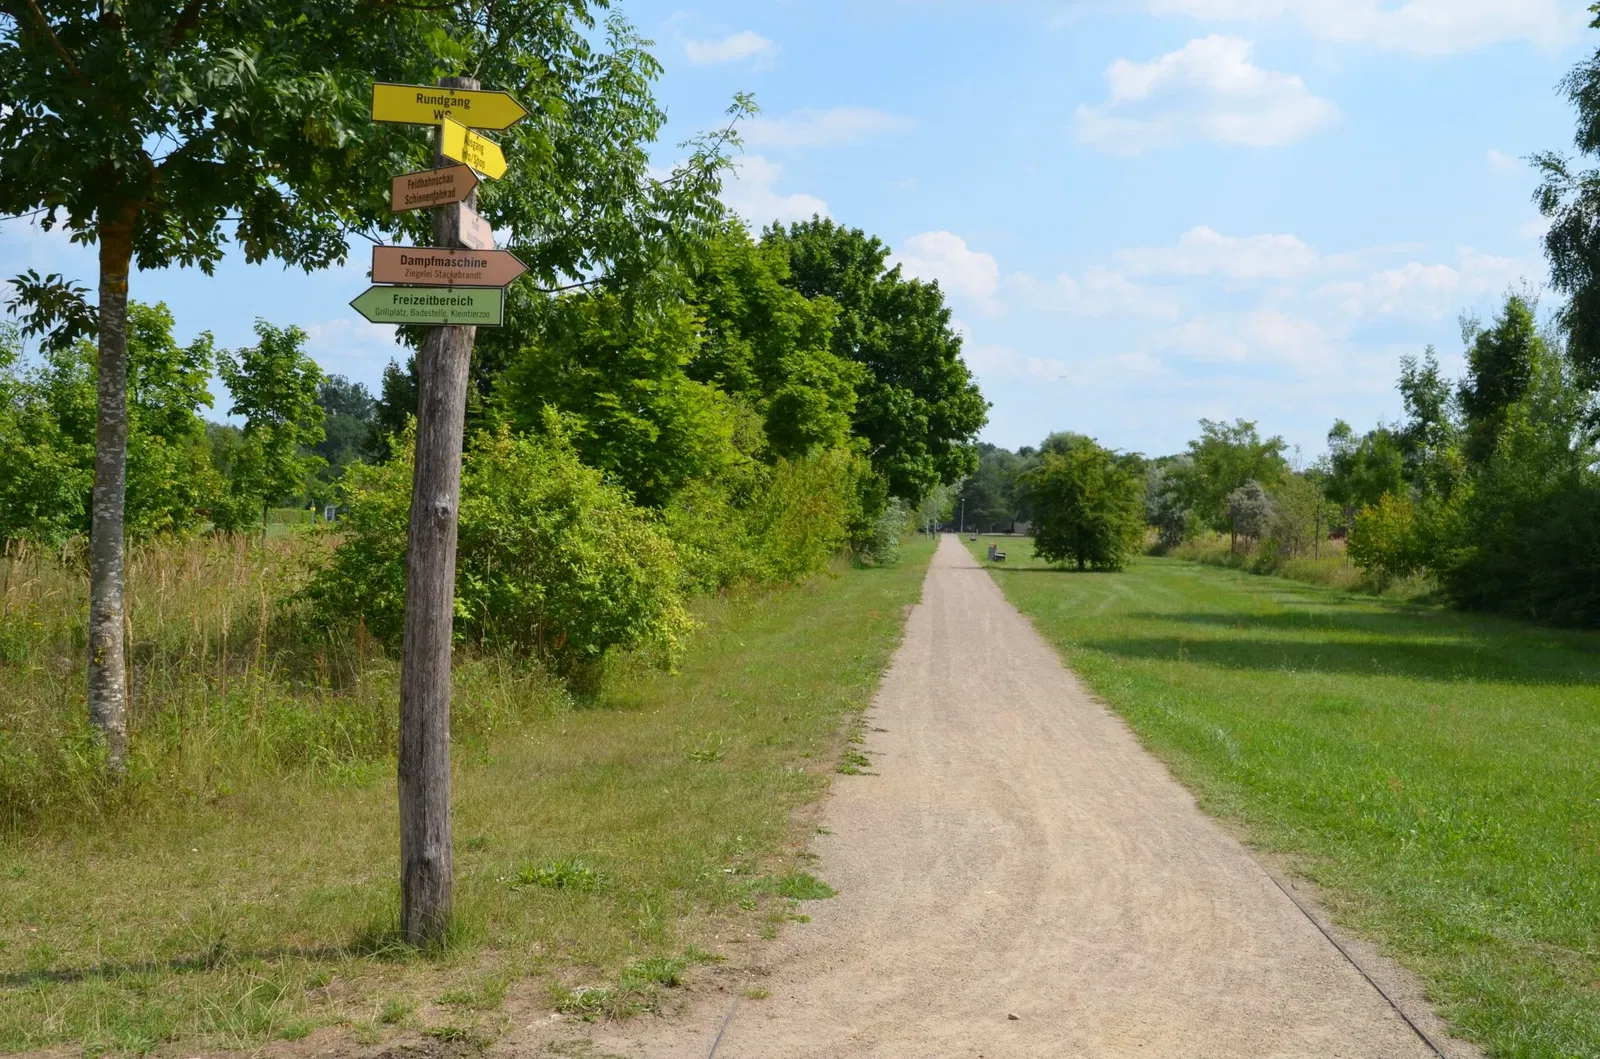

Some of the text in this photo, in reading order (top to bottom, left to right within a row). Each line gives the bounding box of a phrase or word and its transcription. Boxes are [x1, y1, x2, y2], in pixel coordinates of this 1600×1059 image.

[416, 93, 470, 109] Rundgang
[407, 174, 454, 190] Feldbahnschau
[400, 254, 488, 268] Dampfmaschine
[404, 268, 482, 280] Ziegelei Stackebrandt
[393, 294, 474, 306] Freizeitbereich
[375, 307, 409, 317] Grillplatz,
[450, 309, 491, 319] Kleintierzoo
